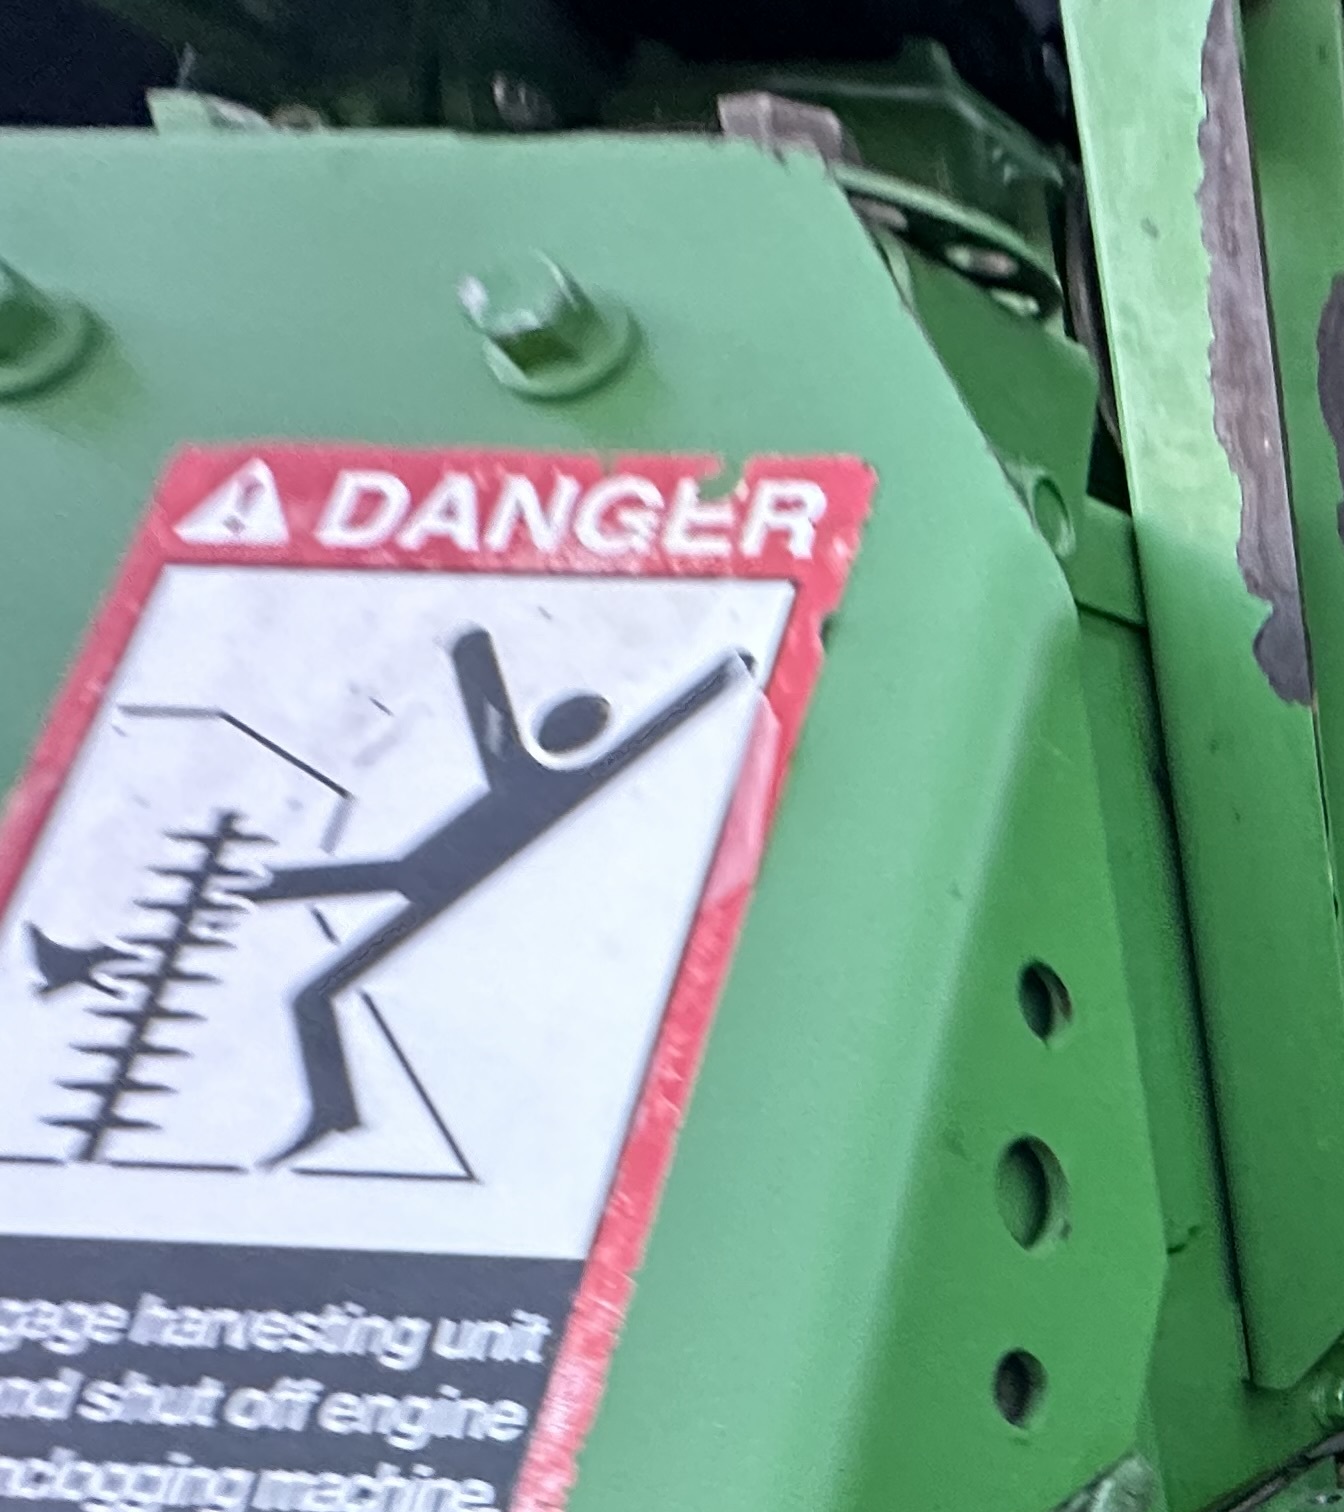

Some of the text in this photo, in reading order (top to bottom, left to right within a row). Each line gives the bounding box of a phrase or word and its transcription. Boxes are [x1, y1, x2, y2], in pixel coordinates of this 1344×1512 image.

[314, 468, 826, 560] DANGER
[127, 1291, 431, 1371] harvesting
[432, 1308, 551, 1364] unit
[76, 1369, 224, 1429] shut
[223, 1375, 324, 1431] off
[317, 1384, 529, 1450] engine
